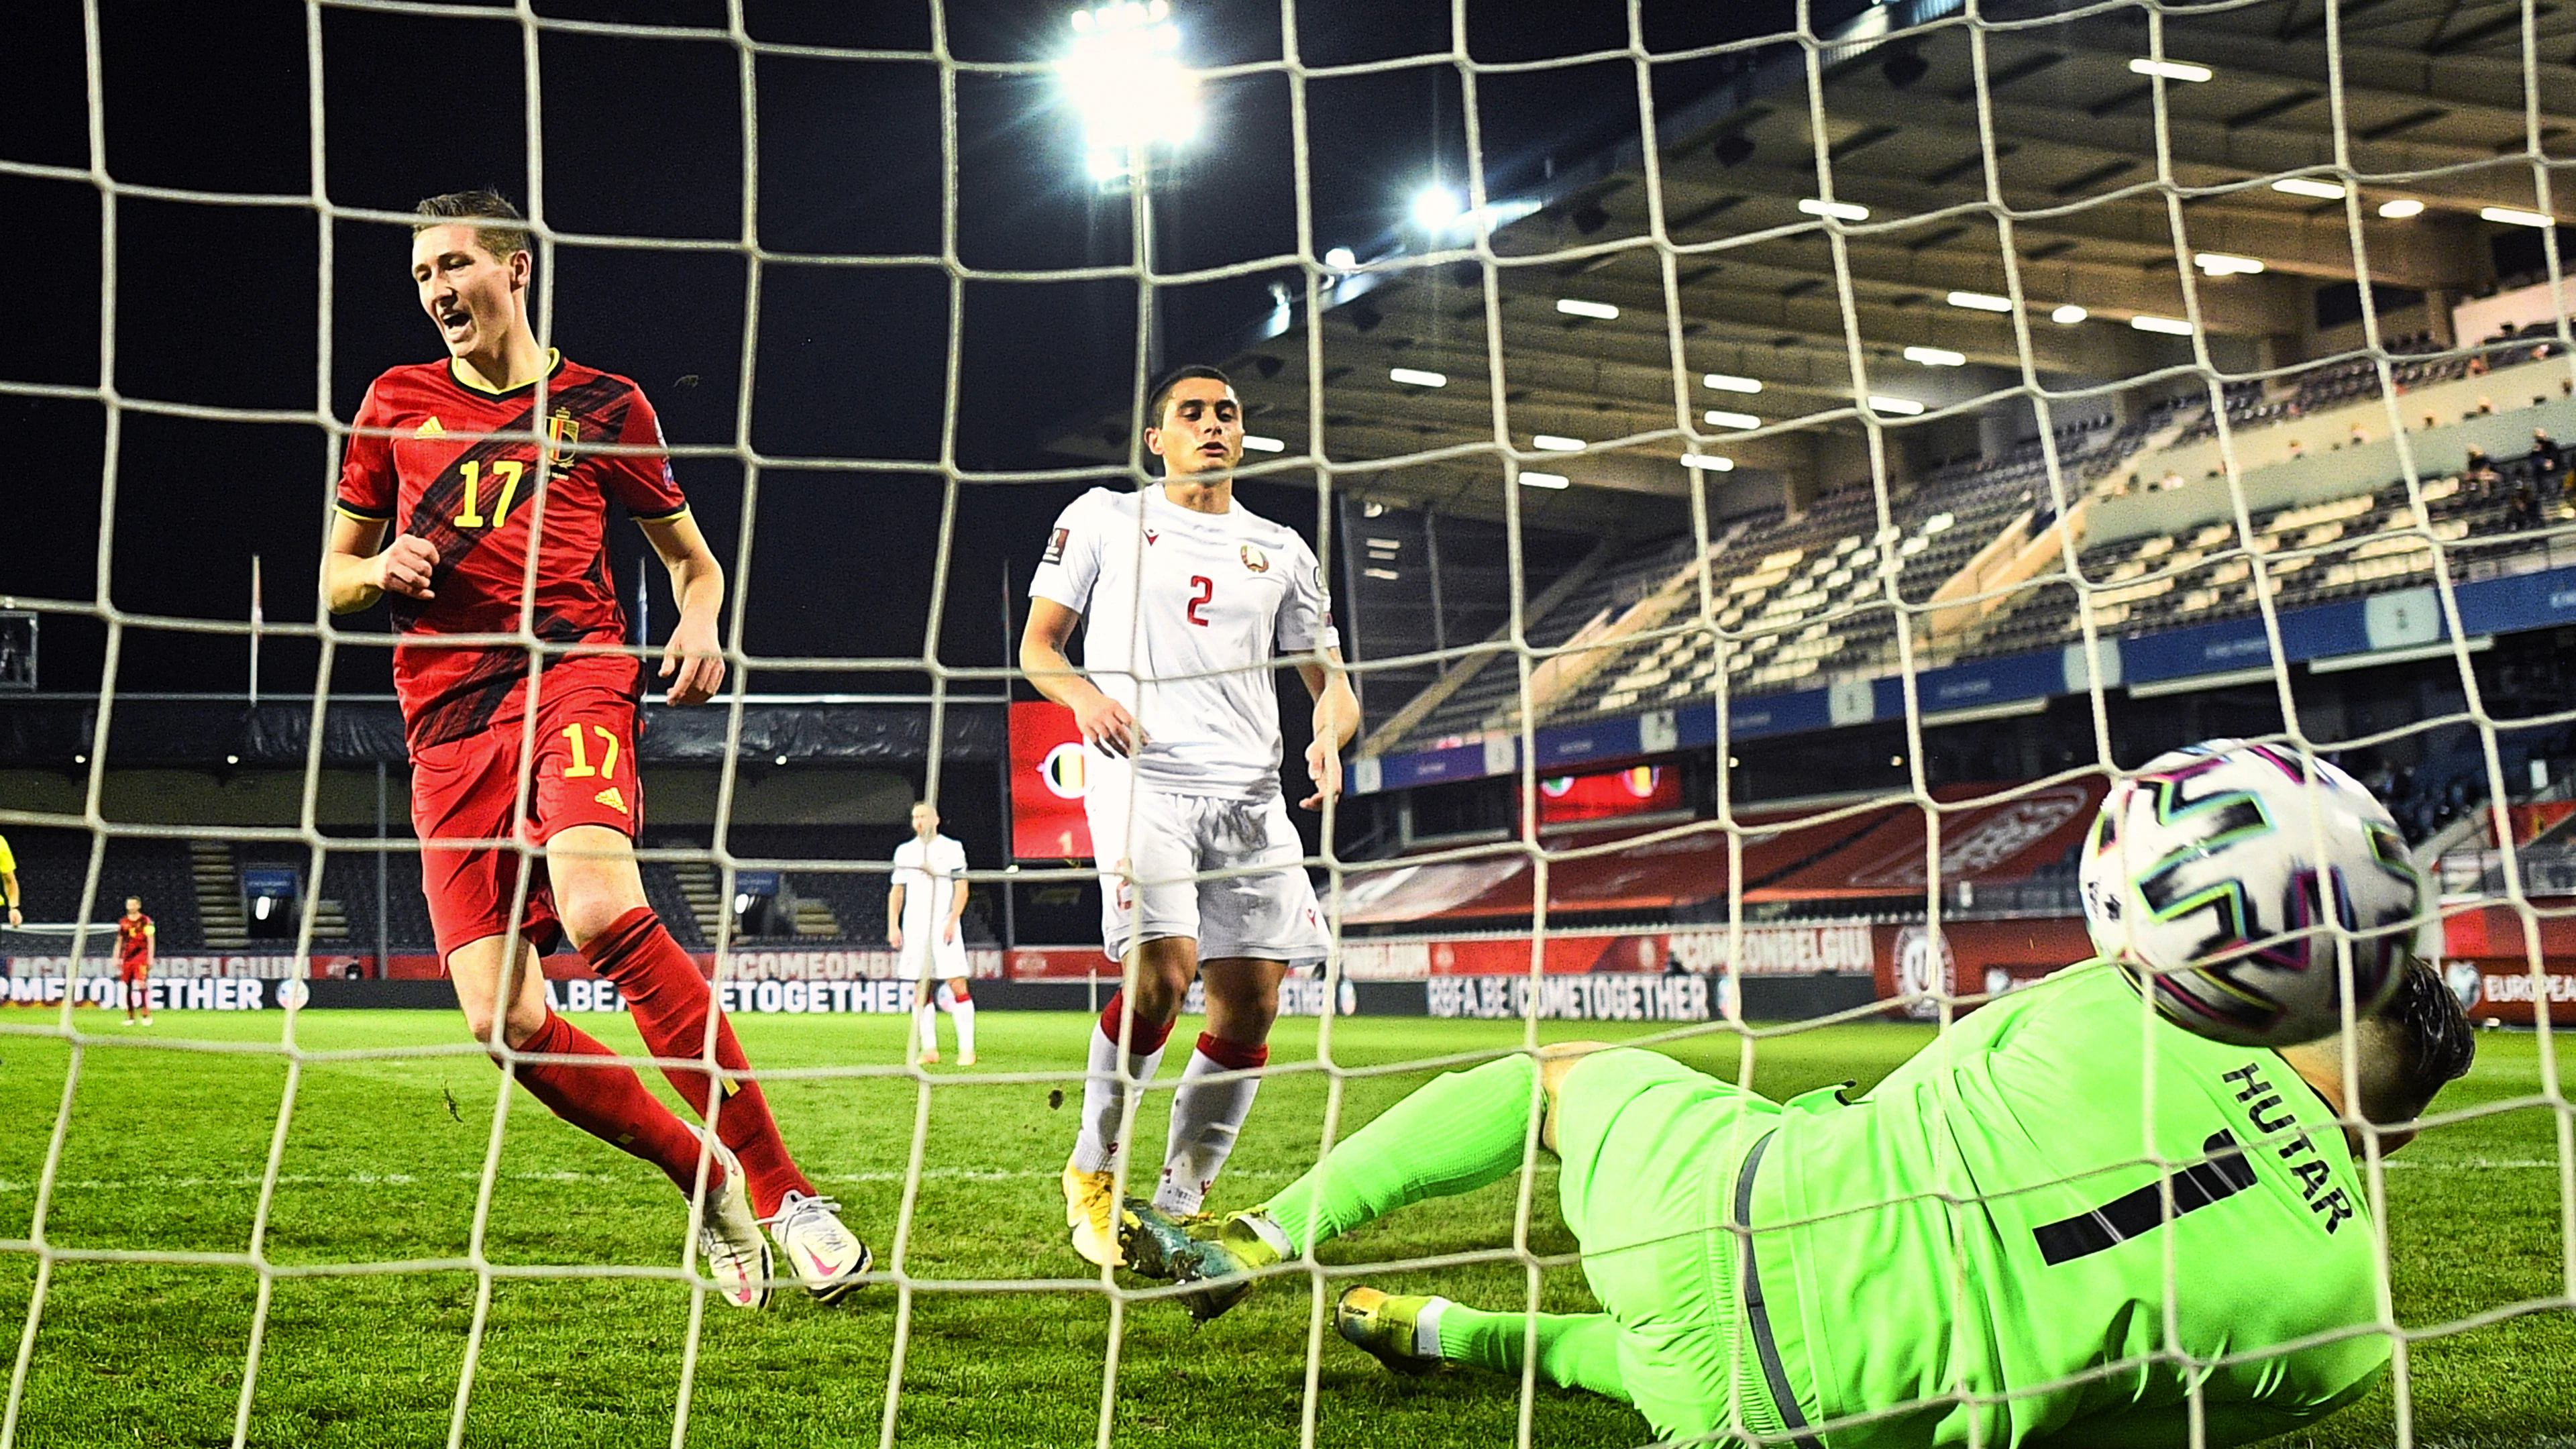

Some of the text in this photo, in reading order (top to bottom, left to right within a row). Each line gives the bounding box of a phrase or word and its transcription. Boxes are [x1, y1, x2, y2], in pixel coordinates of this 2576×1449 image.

[453, 461, 523, 528] 17
[1187, 575, 1212, 627] 2
[561, 722, 620, 780] 17
[2222, 1062, 2353, 1234] HUTAR
[2033, 1128, 2259, 1267] 1
